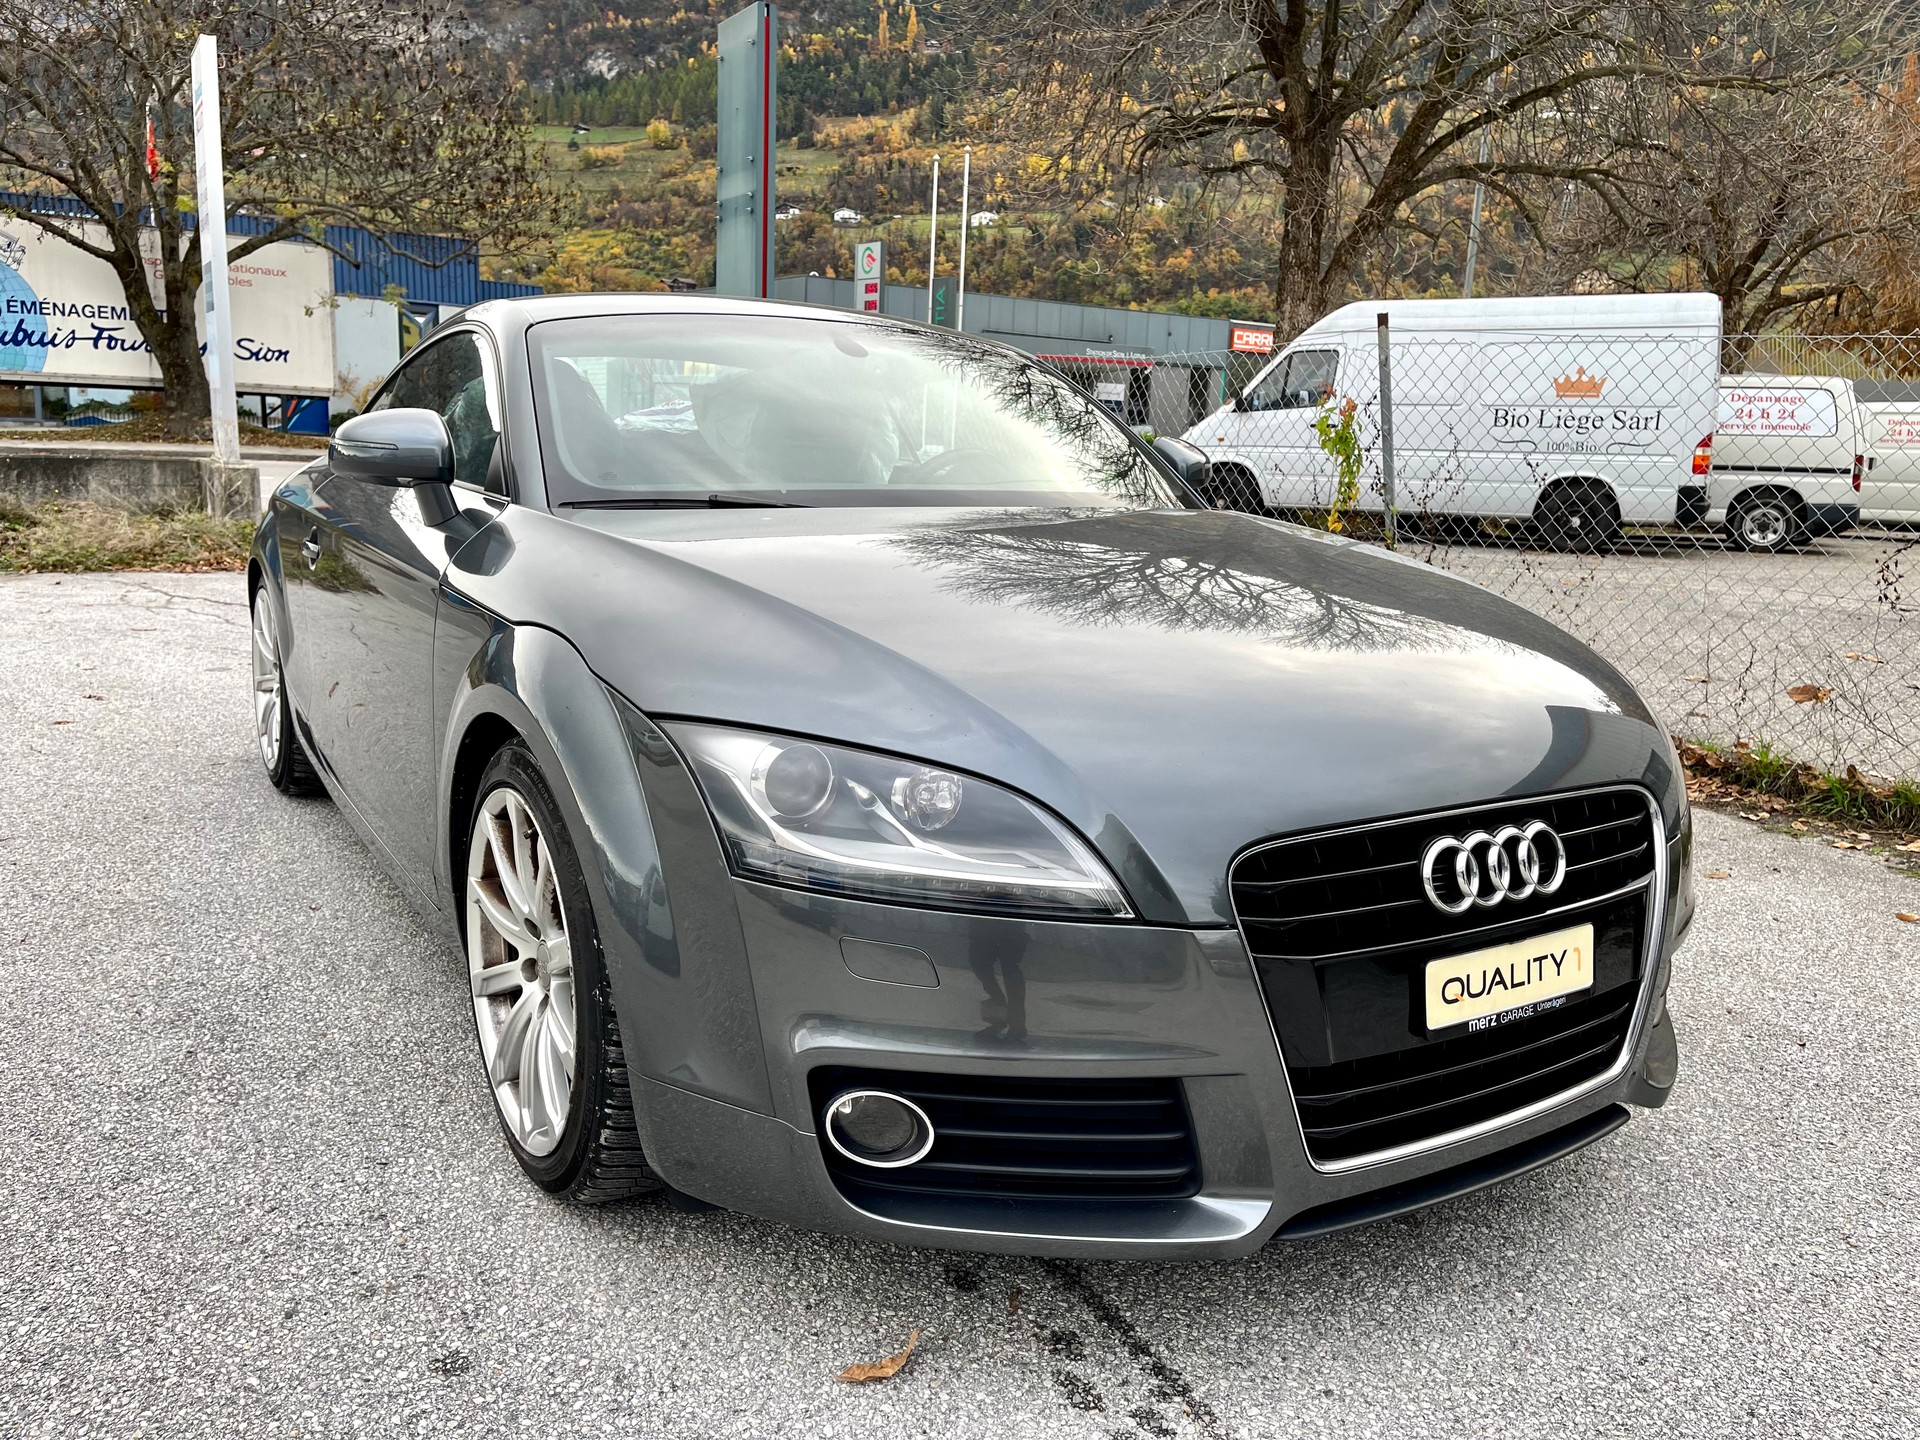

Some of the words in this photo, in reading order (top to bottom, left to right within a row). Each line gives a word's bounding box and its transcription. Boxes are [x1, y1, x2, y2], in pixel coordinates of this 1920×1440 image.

[233, 337, 290, 363] Sion
[1493, 408, 1530, 429] Bio
[1538, 409, 1604, 435] Liège
[1611, 409, 1662, 431] Sarl
[1735, 408, 1753, 420] 24
[1760, 408, 1771, 420] h
[1777, 409, 1797, 420] 24
[1441, 949, 1568, 1005] QUALITY
[1573, 947, 1581, 971] 1
[1468, 1014, 1497, 1032] merz
[1500, 1005, 1535, 1024] GARAGE
